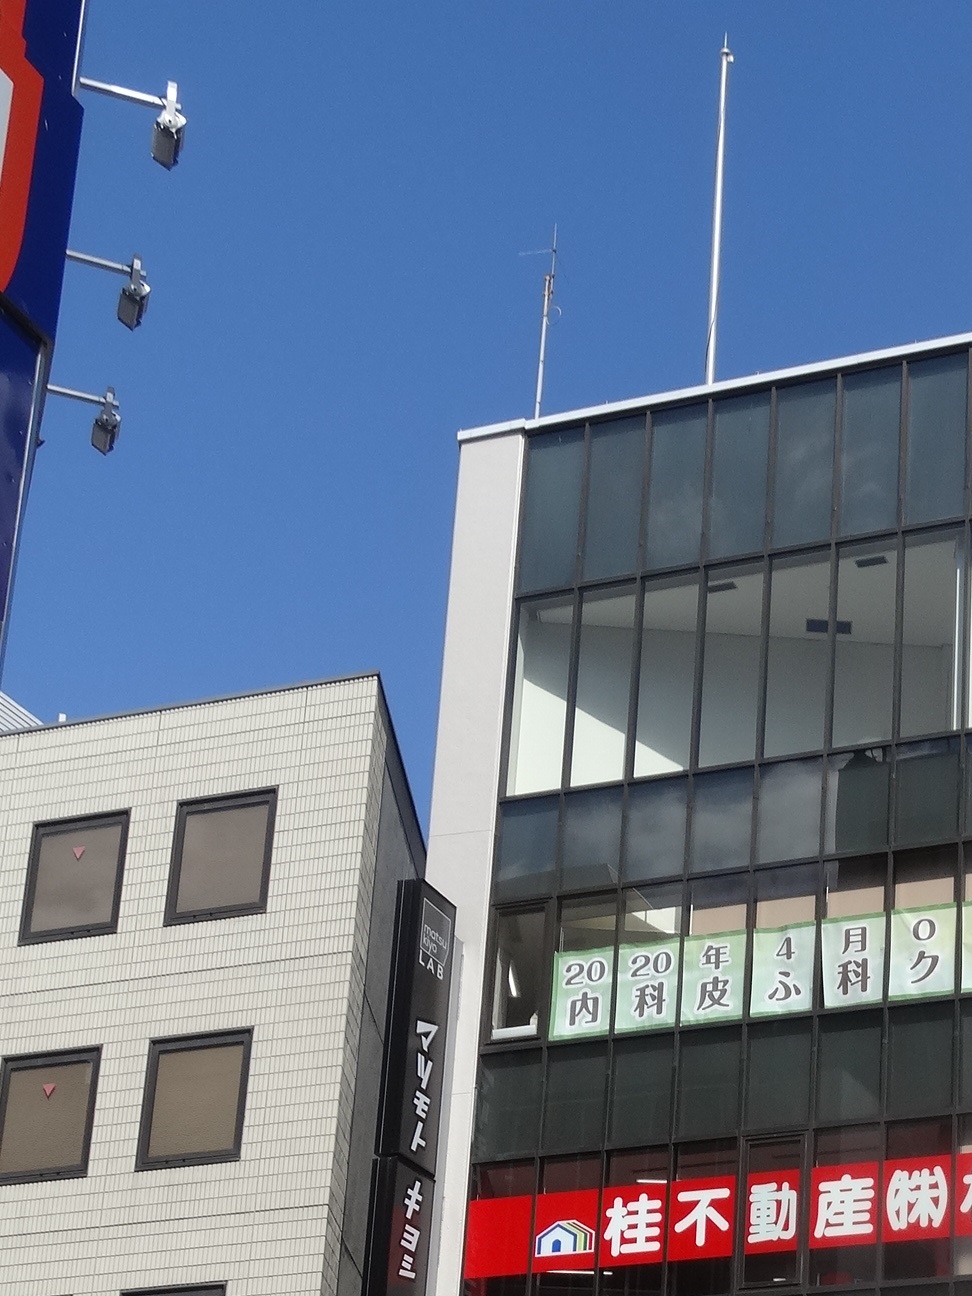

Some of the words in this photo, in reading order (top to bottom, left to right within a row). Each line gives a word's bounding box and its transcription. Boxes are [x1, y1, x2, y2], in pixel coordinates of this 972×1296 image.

[423, 933, 437, 953] kiyo
[424, 924, 447, 950] matsu
[419, 949, 444, 980] LAB
